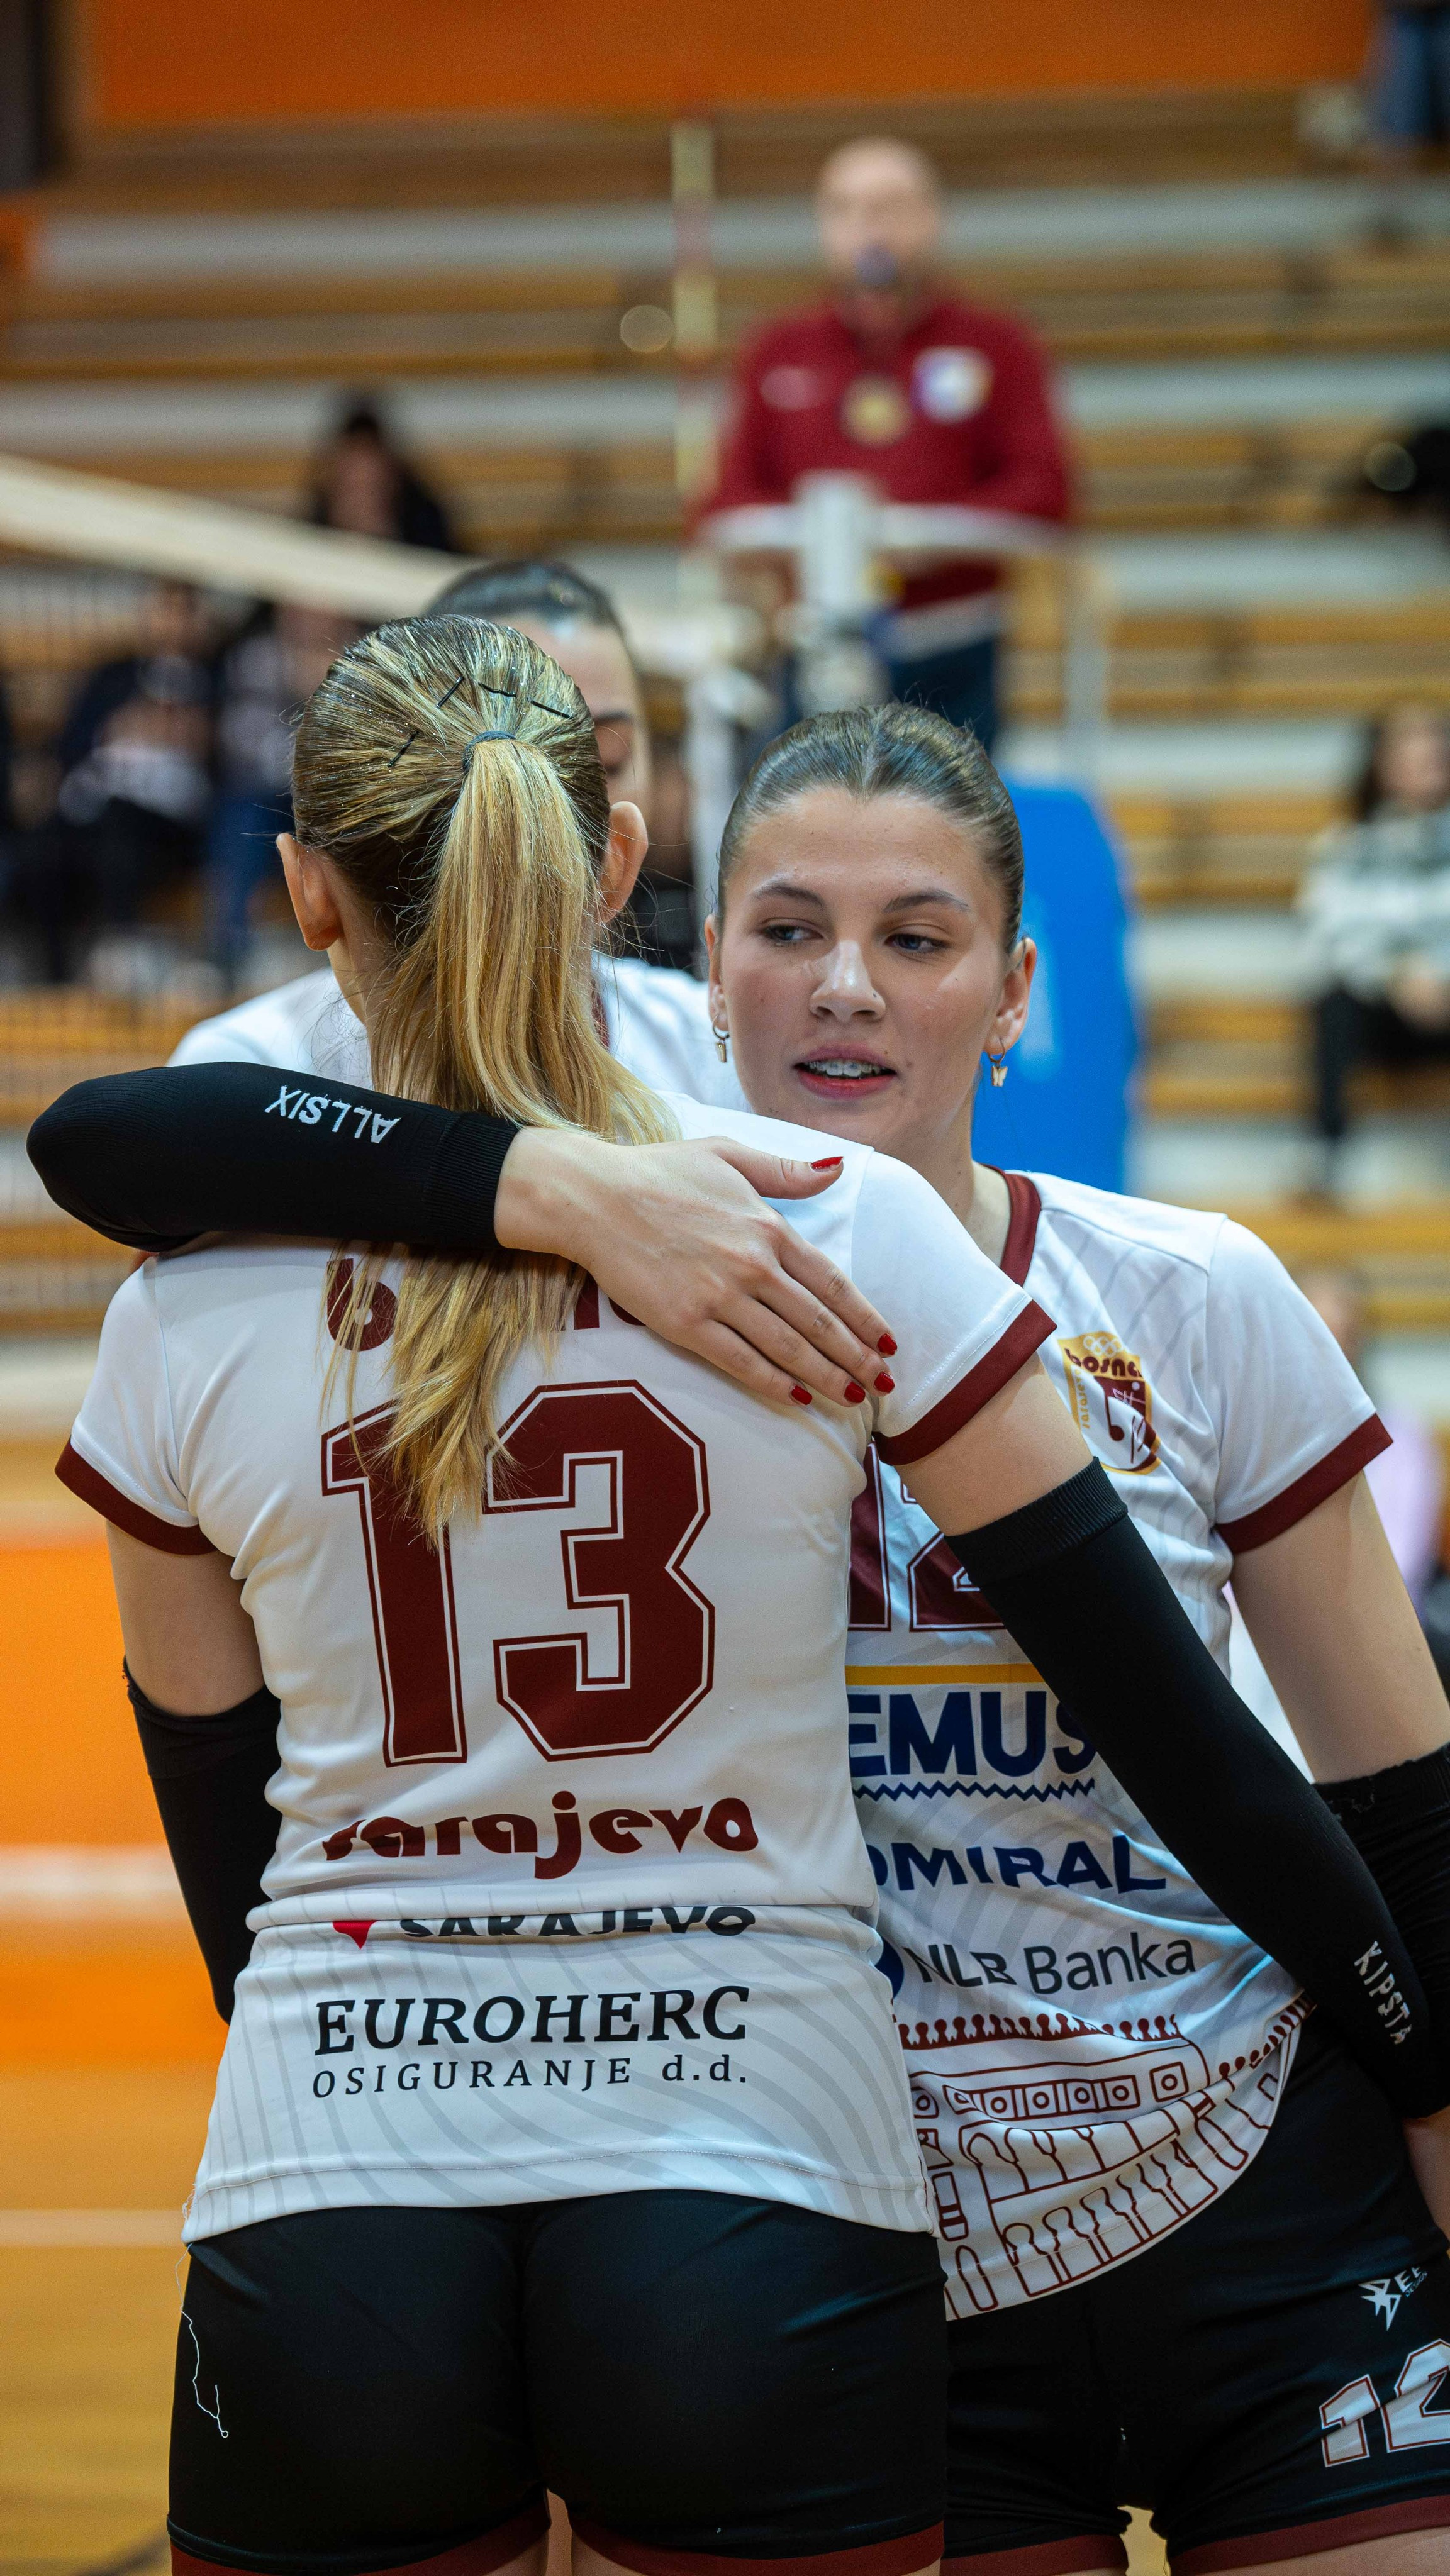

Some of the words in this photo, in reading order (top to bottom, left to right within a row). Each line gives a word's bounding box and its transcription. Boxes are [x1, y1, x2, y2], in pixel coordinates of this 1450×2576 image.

[264, 1084, 403, 1145] ALLSIX
[1064, 1348, 1144, 1378] bosna
[321, 1379, 716, 1768] 13
[321, 1790, 759, 1880] sarajevo
[399, 1906, 757, 1937] SARAJEVO
[901, 1943, 1018, 1988] NLB
[1023, 1931, 1196, 1995] Banka
[1353, 1940, 1413, 2045] KIPSTA
[314, 1985, 750, 2057] EUROHERC
[313, 2057, 632, 2099] OSIGURANJE
[661, 2053, 747, 2084] d.d.
[1319, 2338, 1450, 2468] 12
